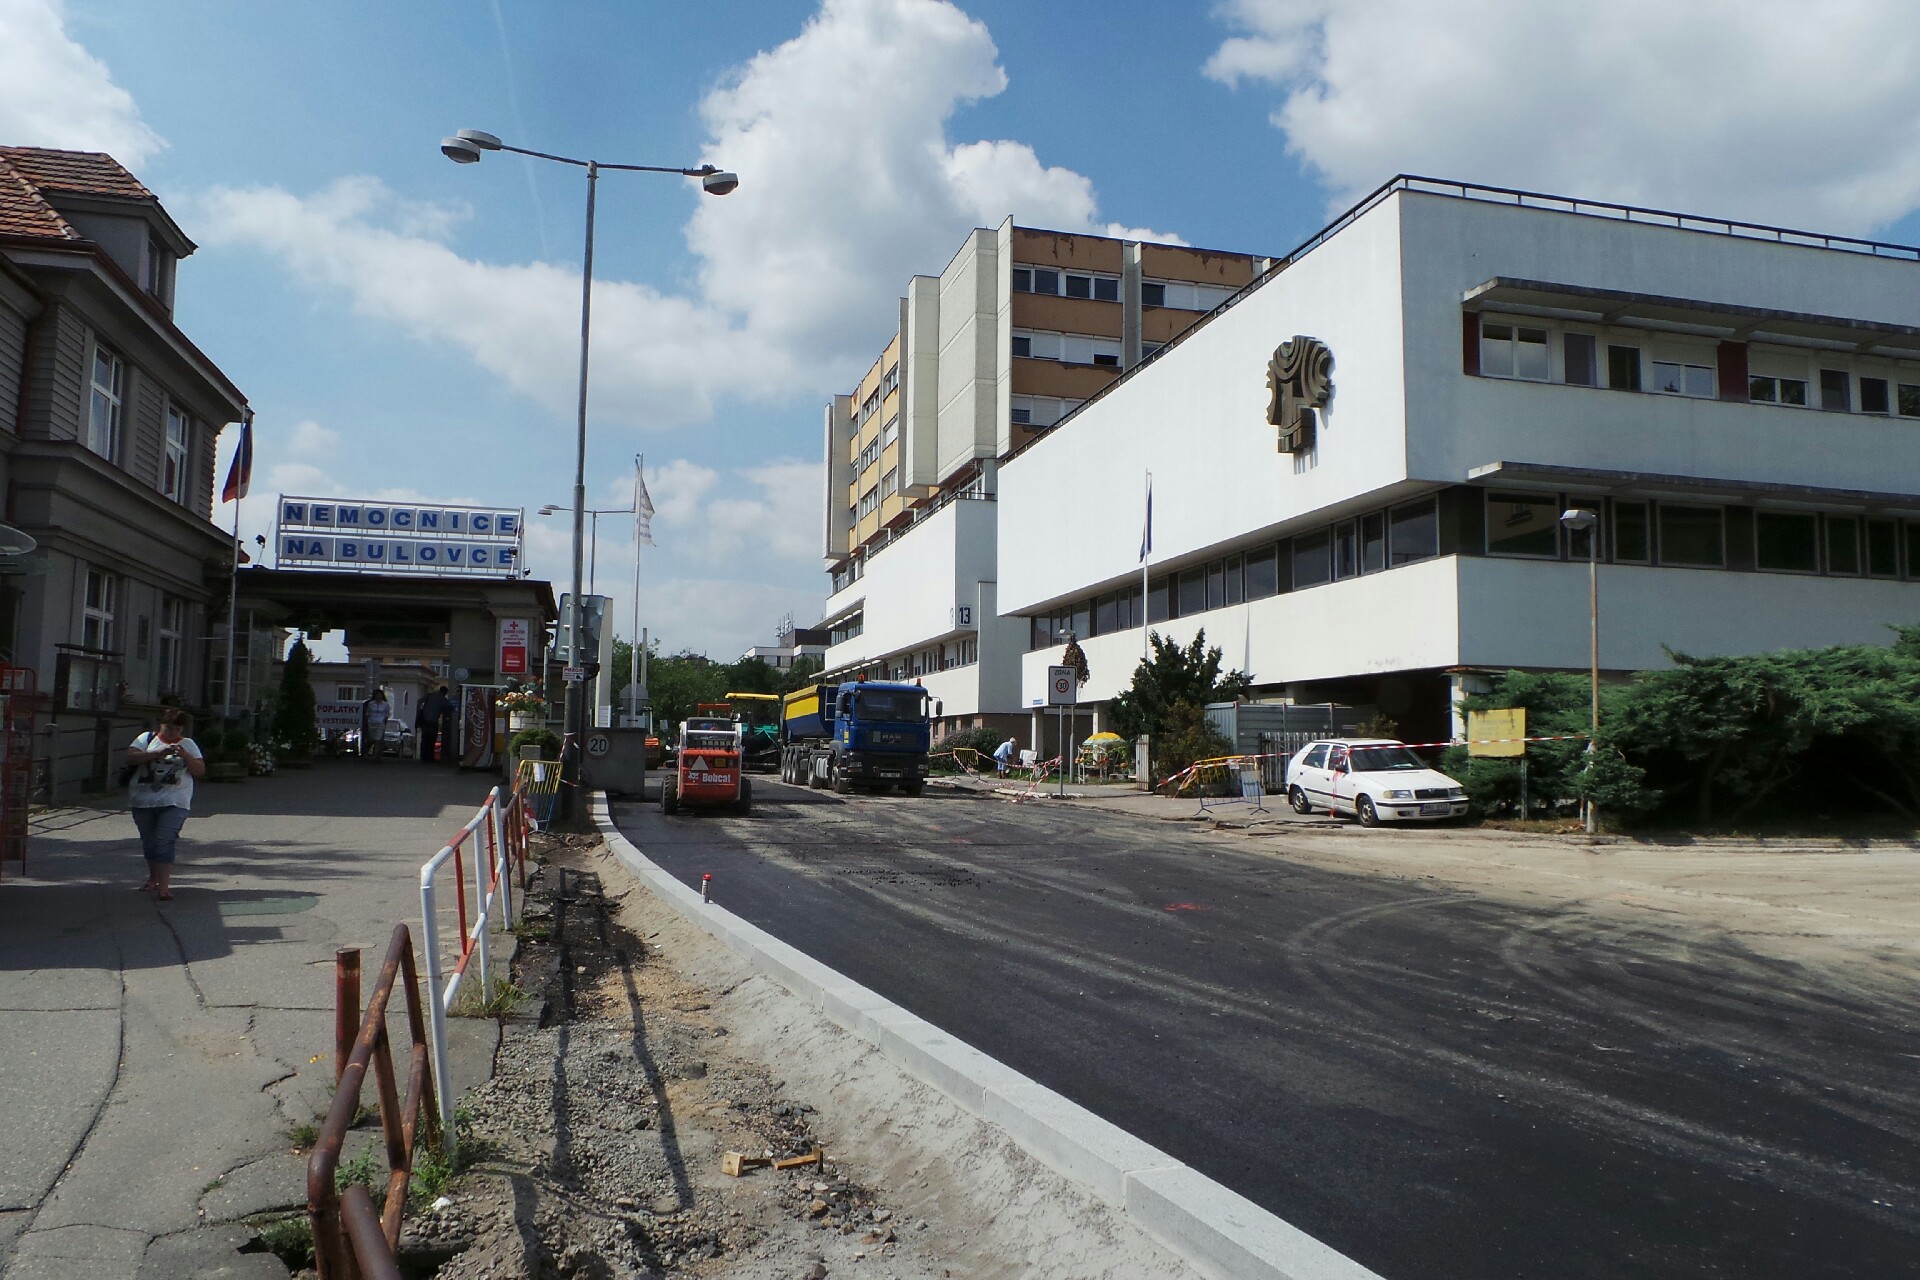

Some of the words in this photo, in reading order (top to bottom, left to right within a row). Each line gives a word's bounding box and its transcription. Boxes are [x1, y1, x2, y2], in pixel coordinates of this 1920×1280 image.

[285, 504, 514, 531] NEMOCNICE
[287, 539, 324, 556] NA
[342, 542, 512, 564] BULOVCE
[959, 606, 971, 625] 13
[1058, 682, 1067, 690] 30
[317, 705, 360, 713] POPLATKY
[590, 738, 607, 752] 20
[702, 773, 731, 783] Bobcat
